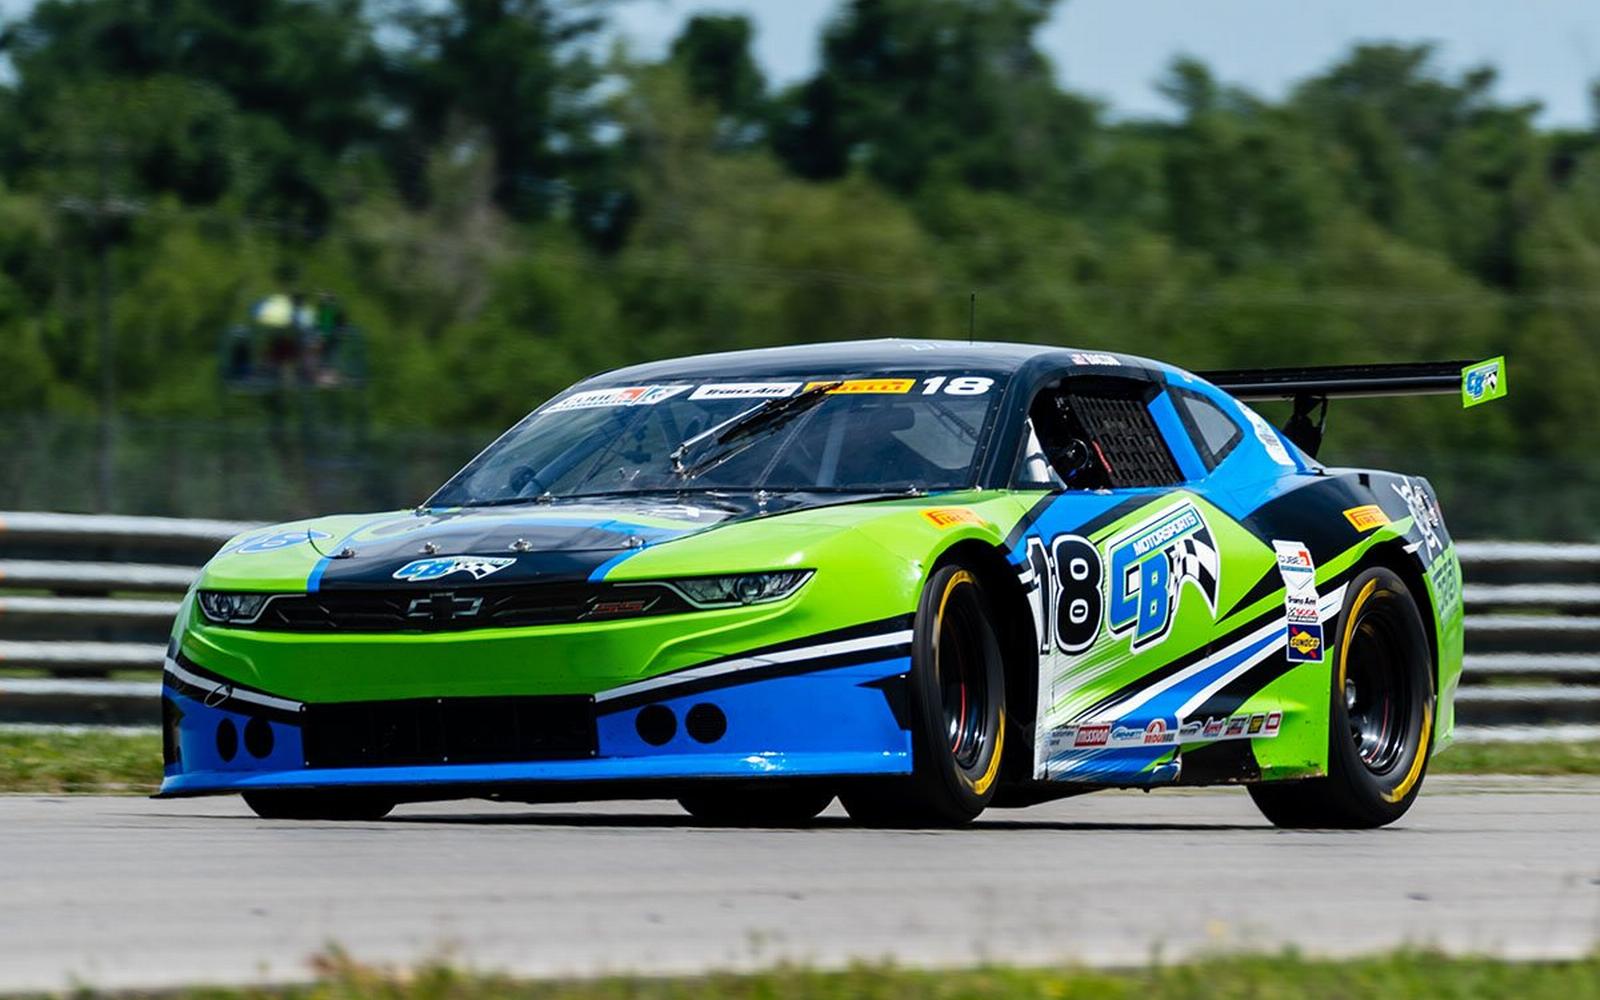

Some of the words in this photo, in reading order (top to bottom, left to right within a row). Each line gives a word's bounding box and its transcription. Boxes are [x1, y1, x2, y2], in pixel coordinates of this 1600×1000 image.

[921, 375, 995, 395] 18
[1132, 511, 1197, 557] MOTORSPORTS
[1027, 534, 1103, 655] 18
[1108, 546, 1172, 648] CB
[1291, 637, 1319, 648] SUNOCO
